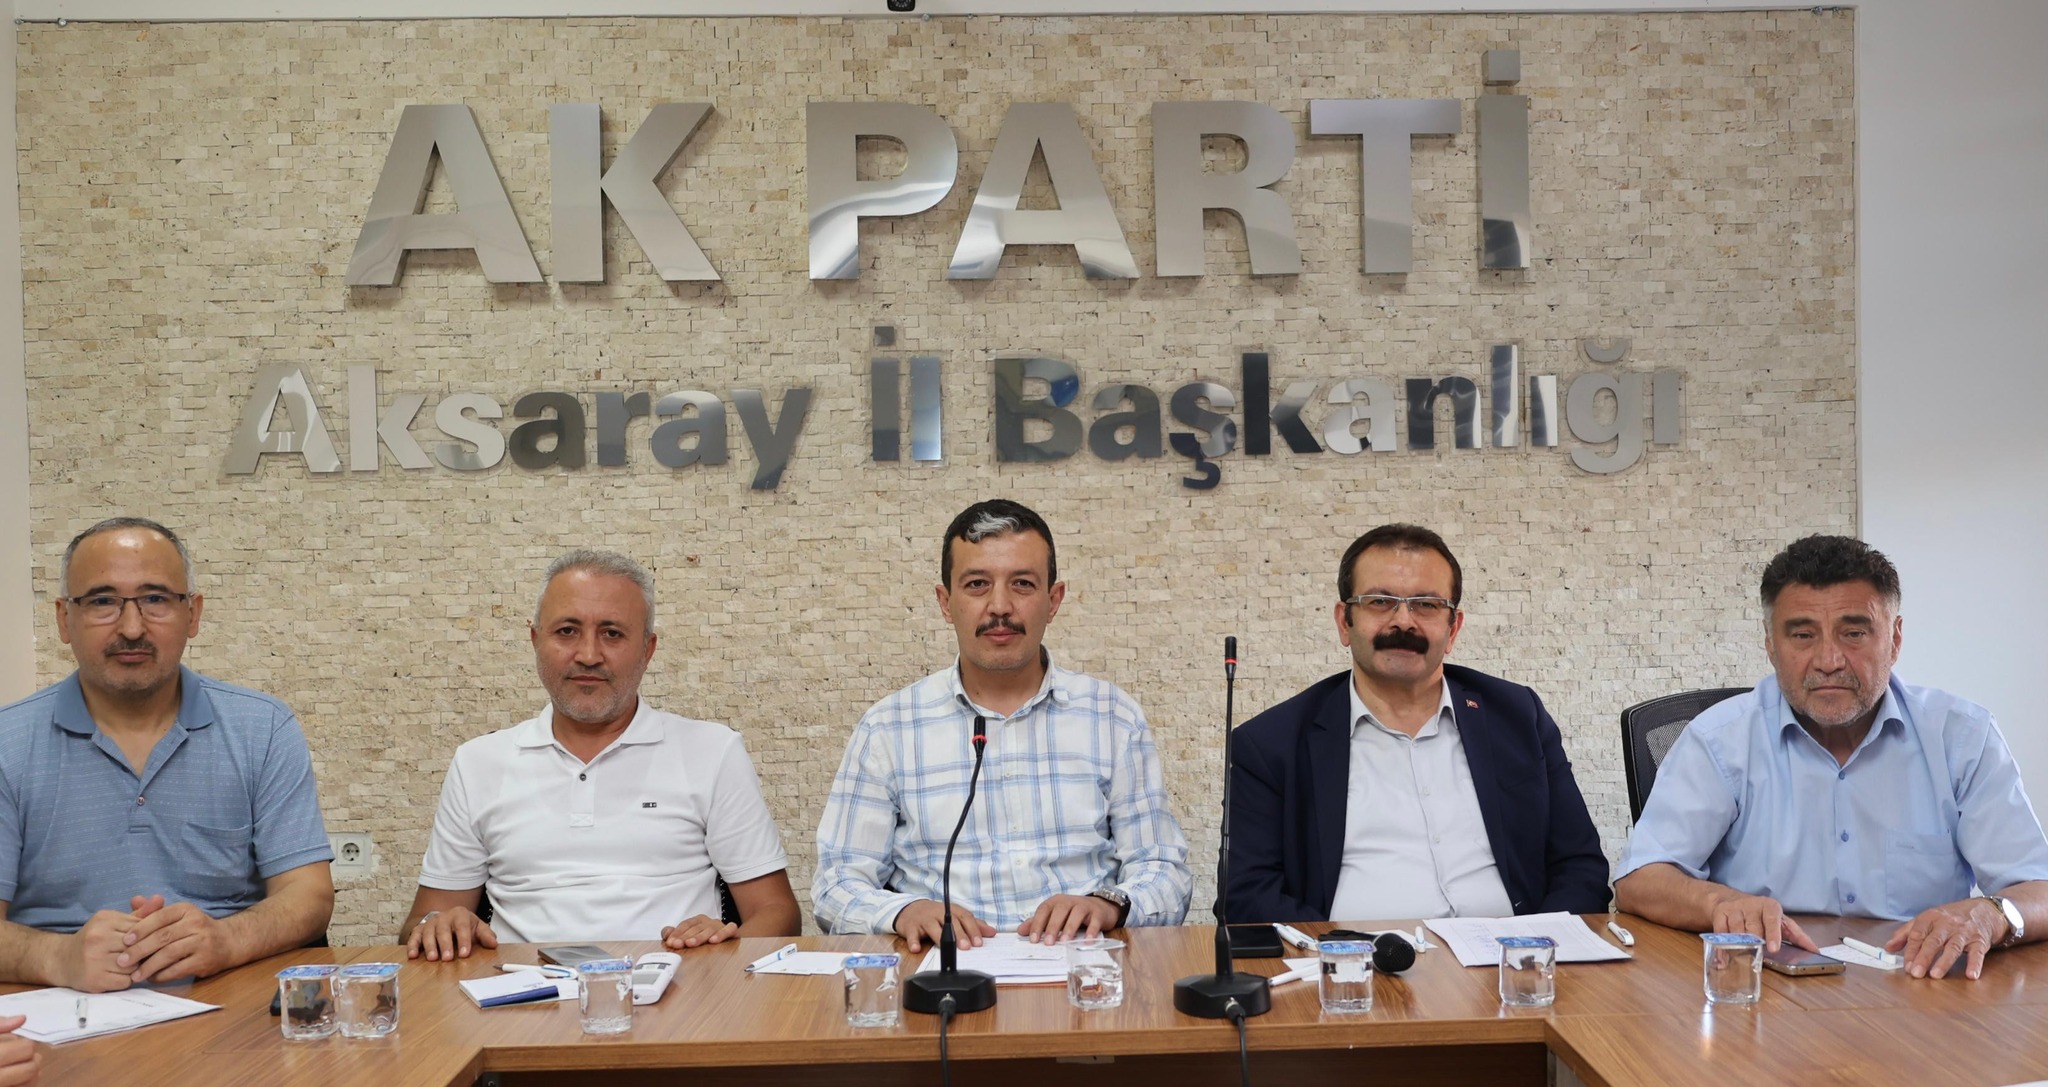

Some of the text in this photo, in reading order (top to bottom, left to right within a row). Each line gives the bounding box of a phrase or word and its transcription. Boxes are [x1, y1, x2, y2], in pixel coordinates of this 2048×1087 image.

[344, 49, 1531, 287] AK PARTİ
[225, 325, 1682, 491] Aksaray İl Başkanlığı
